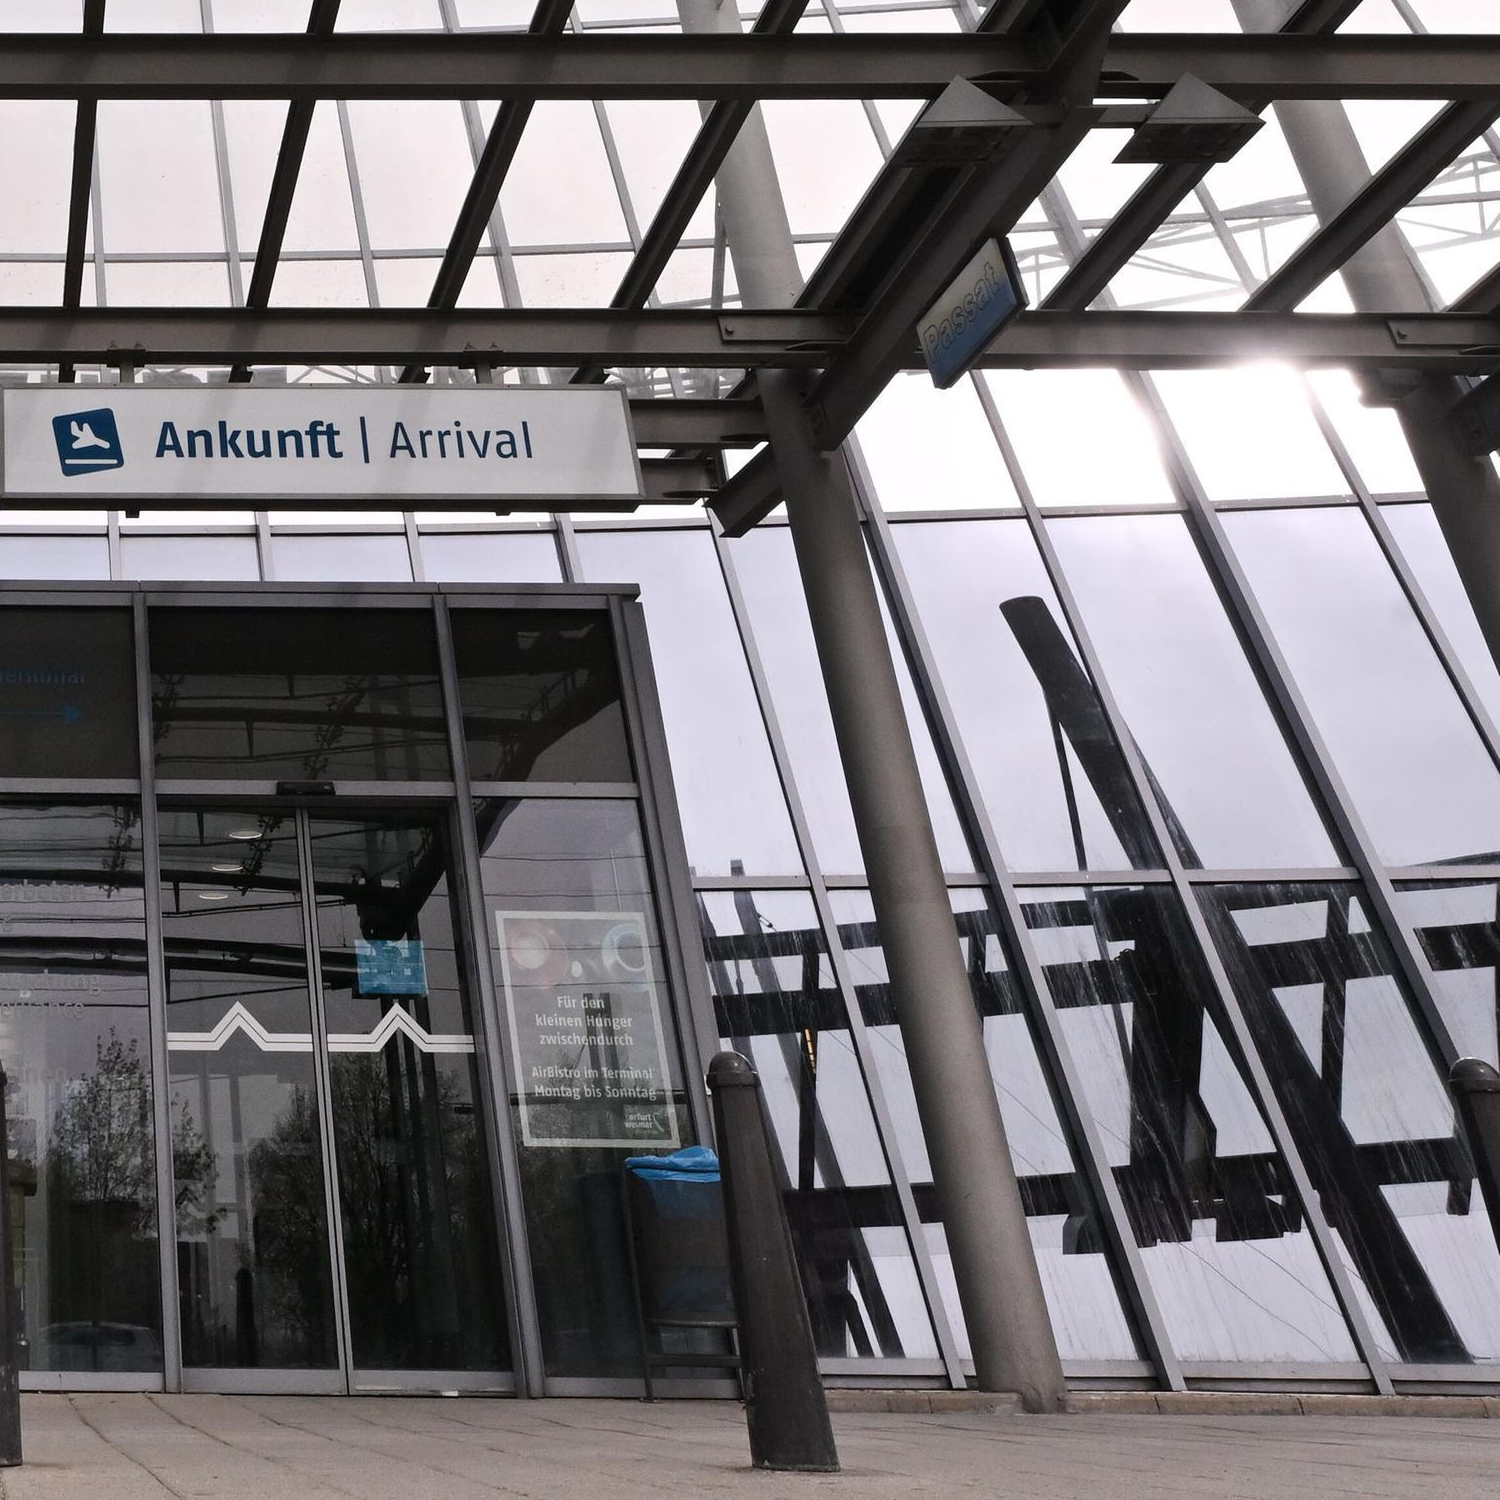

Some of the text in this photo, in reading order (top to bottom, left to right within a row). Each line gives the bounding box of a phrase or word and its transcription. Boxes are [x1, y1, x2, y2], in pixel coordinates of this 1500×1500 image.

[922, 261, 999, 365] Passat
[155, 420, 344, 459] Ankunft
[389, 420, 533, 459] Arrival
[557, 996, 605, 1009] Für den
[535, 1013, 633, 1030] kleinen Hunger
[539, 1032, 634, 1046] zwischendurch
[532, 1066, 581, 1078] AirBistro
[601, 1067, 653, 1079] Terminal
[534, 1084, 657, 1101] Montag bis Sonntag
